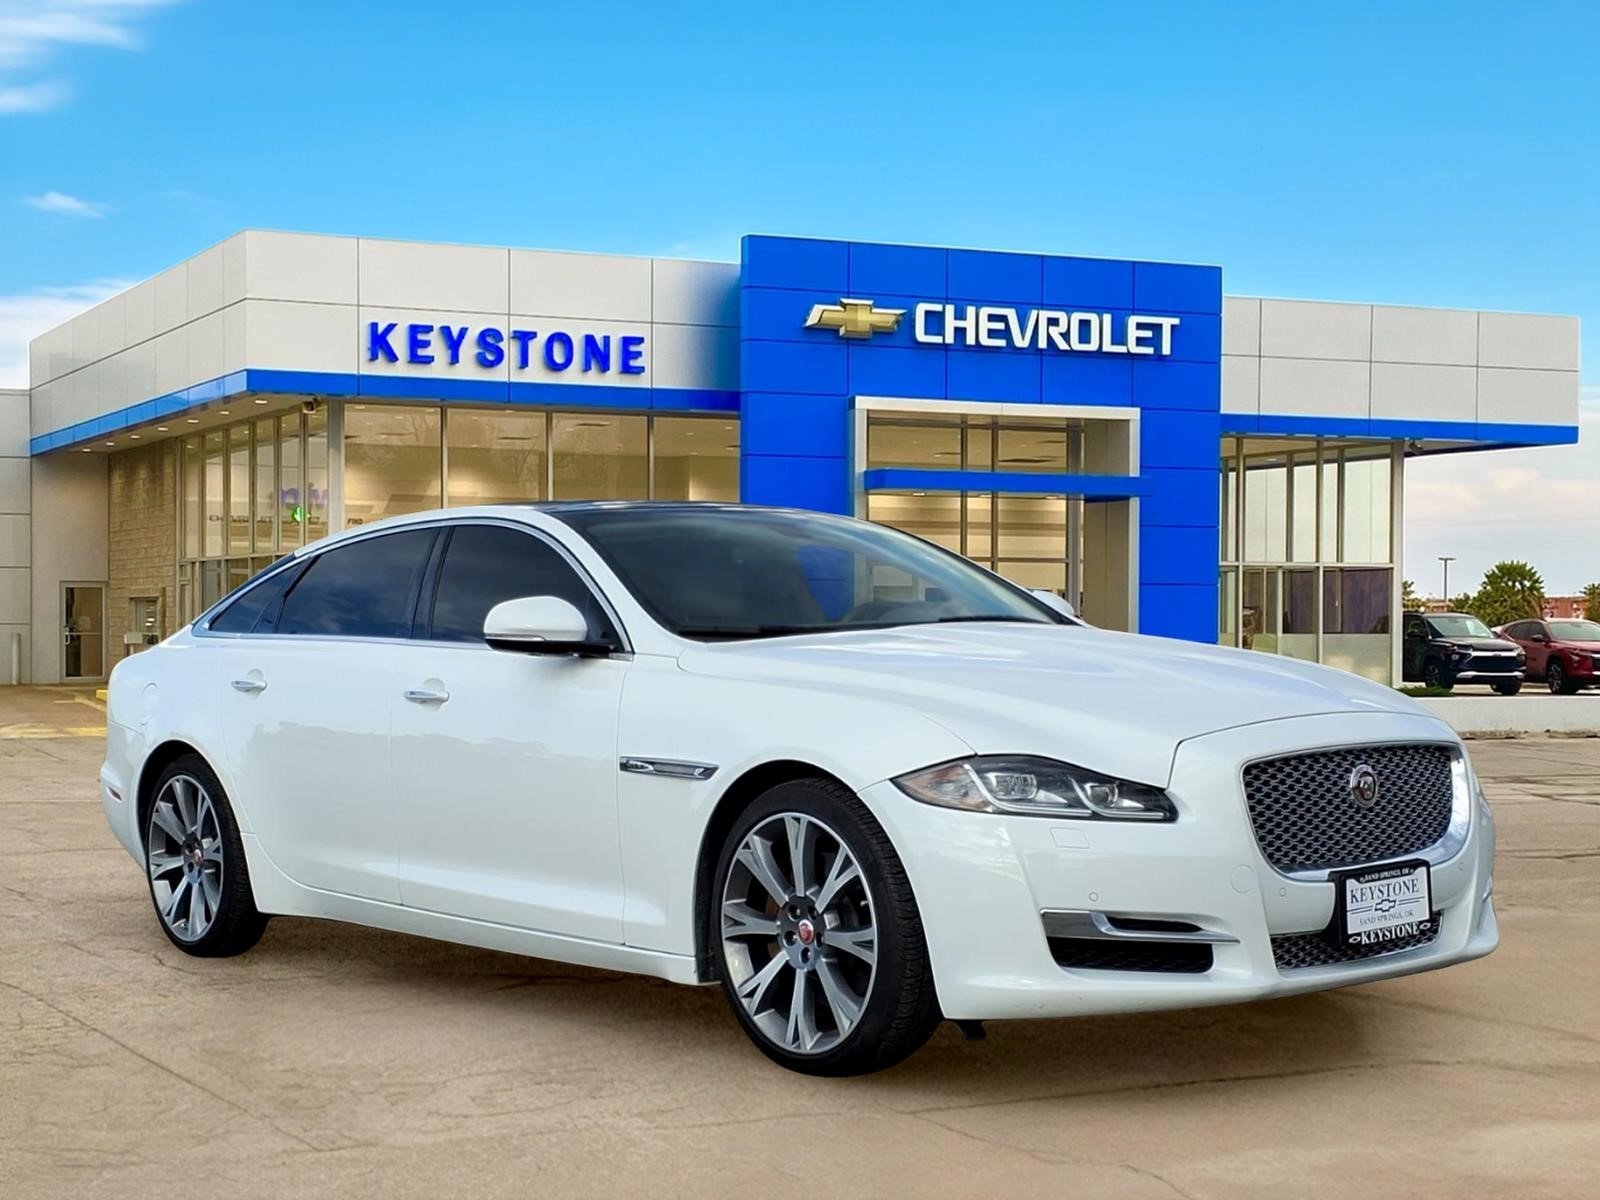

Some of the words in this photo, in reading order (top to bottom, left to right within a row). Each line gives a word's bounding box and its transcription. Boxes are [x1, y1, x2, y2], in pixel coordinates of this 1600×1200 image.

[914, 302, 1181, 355] CHEVROLET
[368, 321, 646, 375] KEYSTONE
[1350, 878, 1419, 904] KEYSTONE
[1360, 916, 1376, 926] SAND
[1404, 909, 1415, 918] OK
[1361, 921, 1420, 945] KEYSTONE
